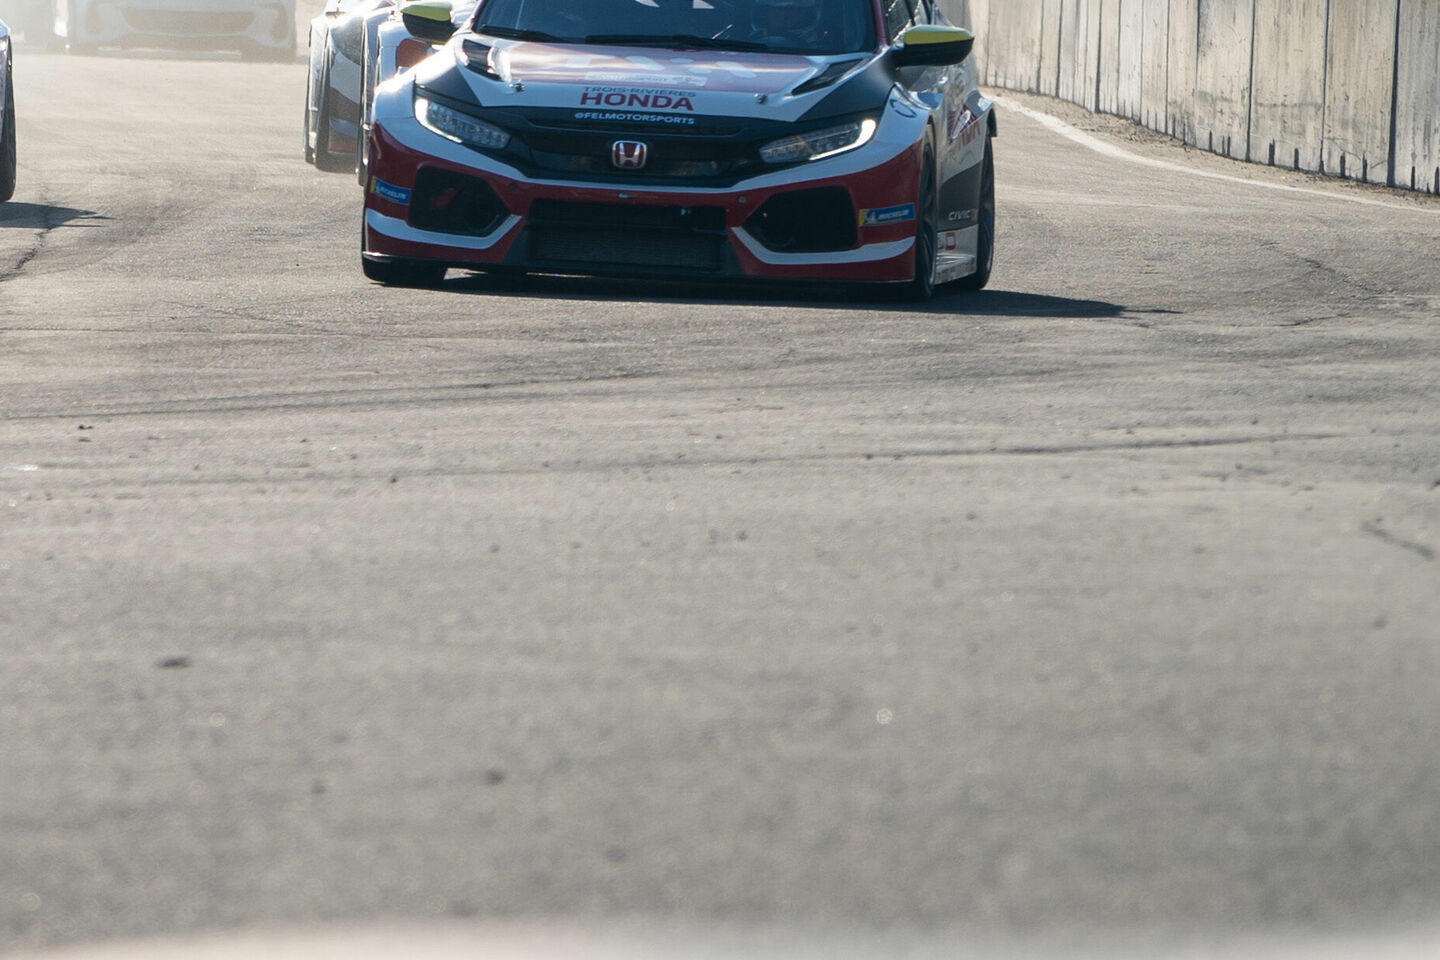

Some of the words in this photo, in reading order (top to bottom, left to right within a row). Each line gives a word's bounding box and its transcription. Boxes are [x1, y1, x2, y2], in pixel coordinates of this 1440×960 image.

[580, 92, 694, 111] HONDA
[574, 112, 695, 125] @FELMOTORSPORTS
[948, 209, 971, 221] CIVIC
